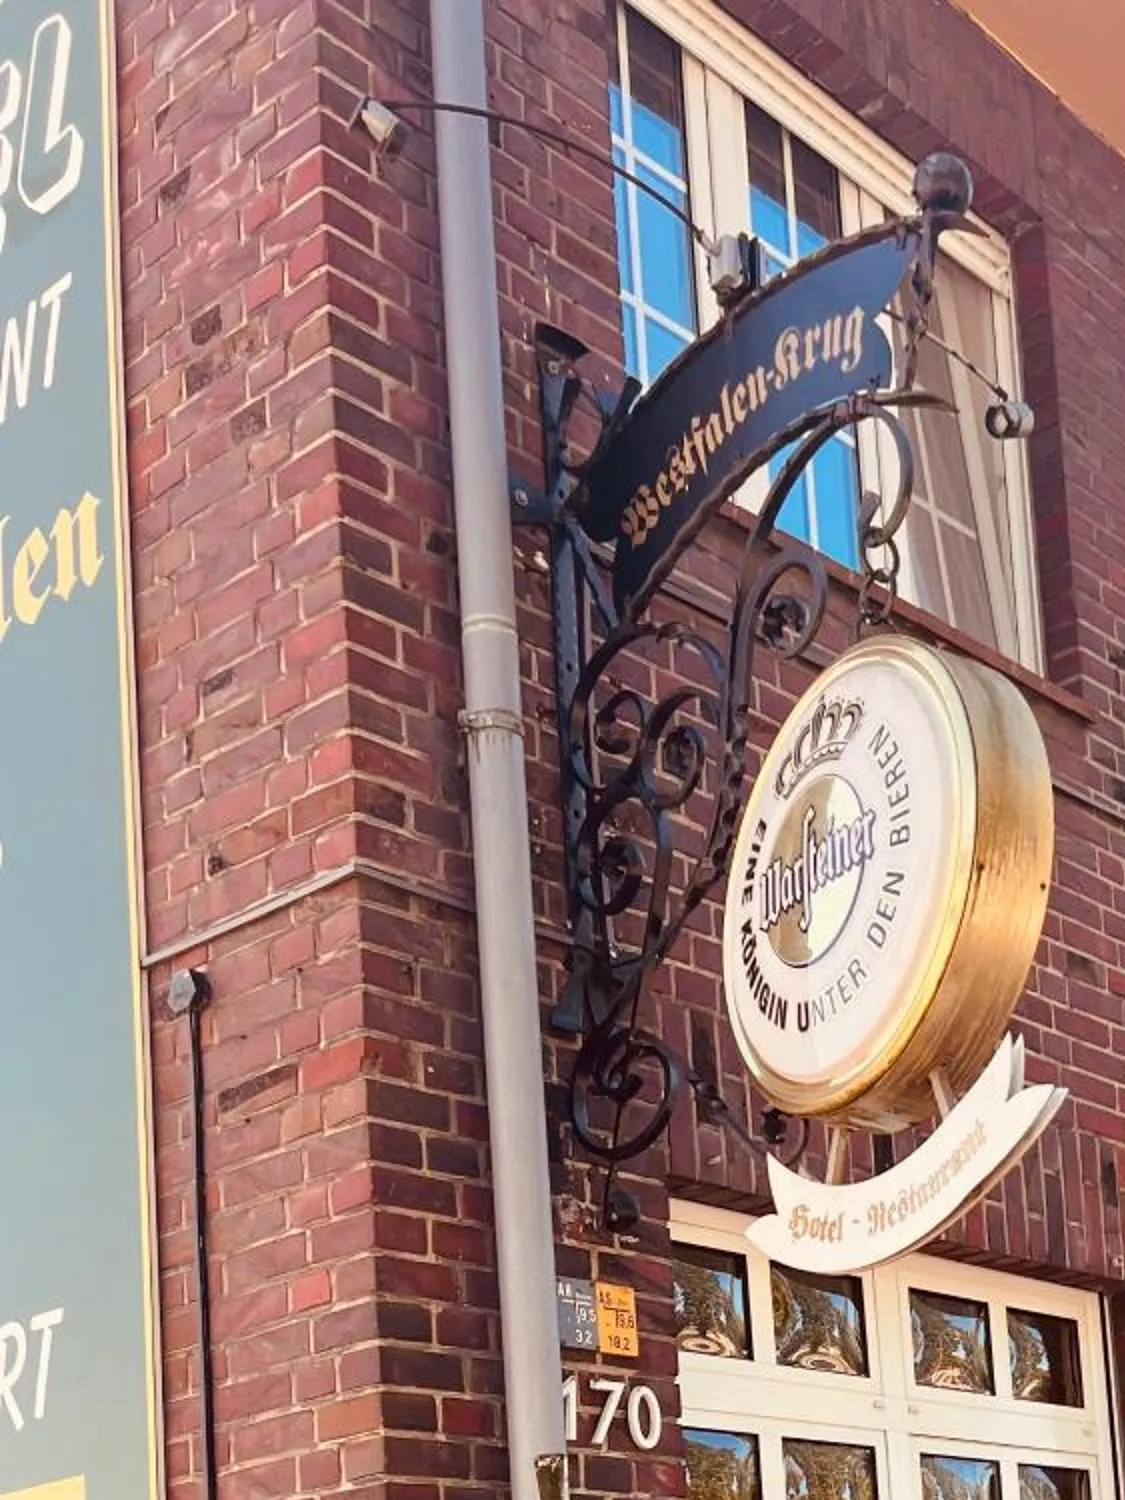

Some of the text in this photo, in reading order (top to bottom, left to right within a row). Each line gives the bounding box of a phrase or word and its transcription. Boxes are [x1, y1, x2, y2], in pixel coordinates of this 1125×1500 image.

[867, 725, 911, 847] BIEREN
[740, 818, 767, 905] EINE
[867, 870, 905, 949] DEN
[796, 959, 868, 1033] UNTER
[788, 1203, 845, 1244] Hotel
[560, 1376, 662, 1450] 170
